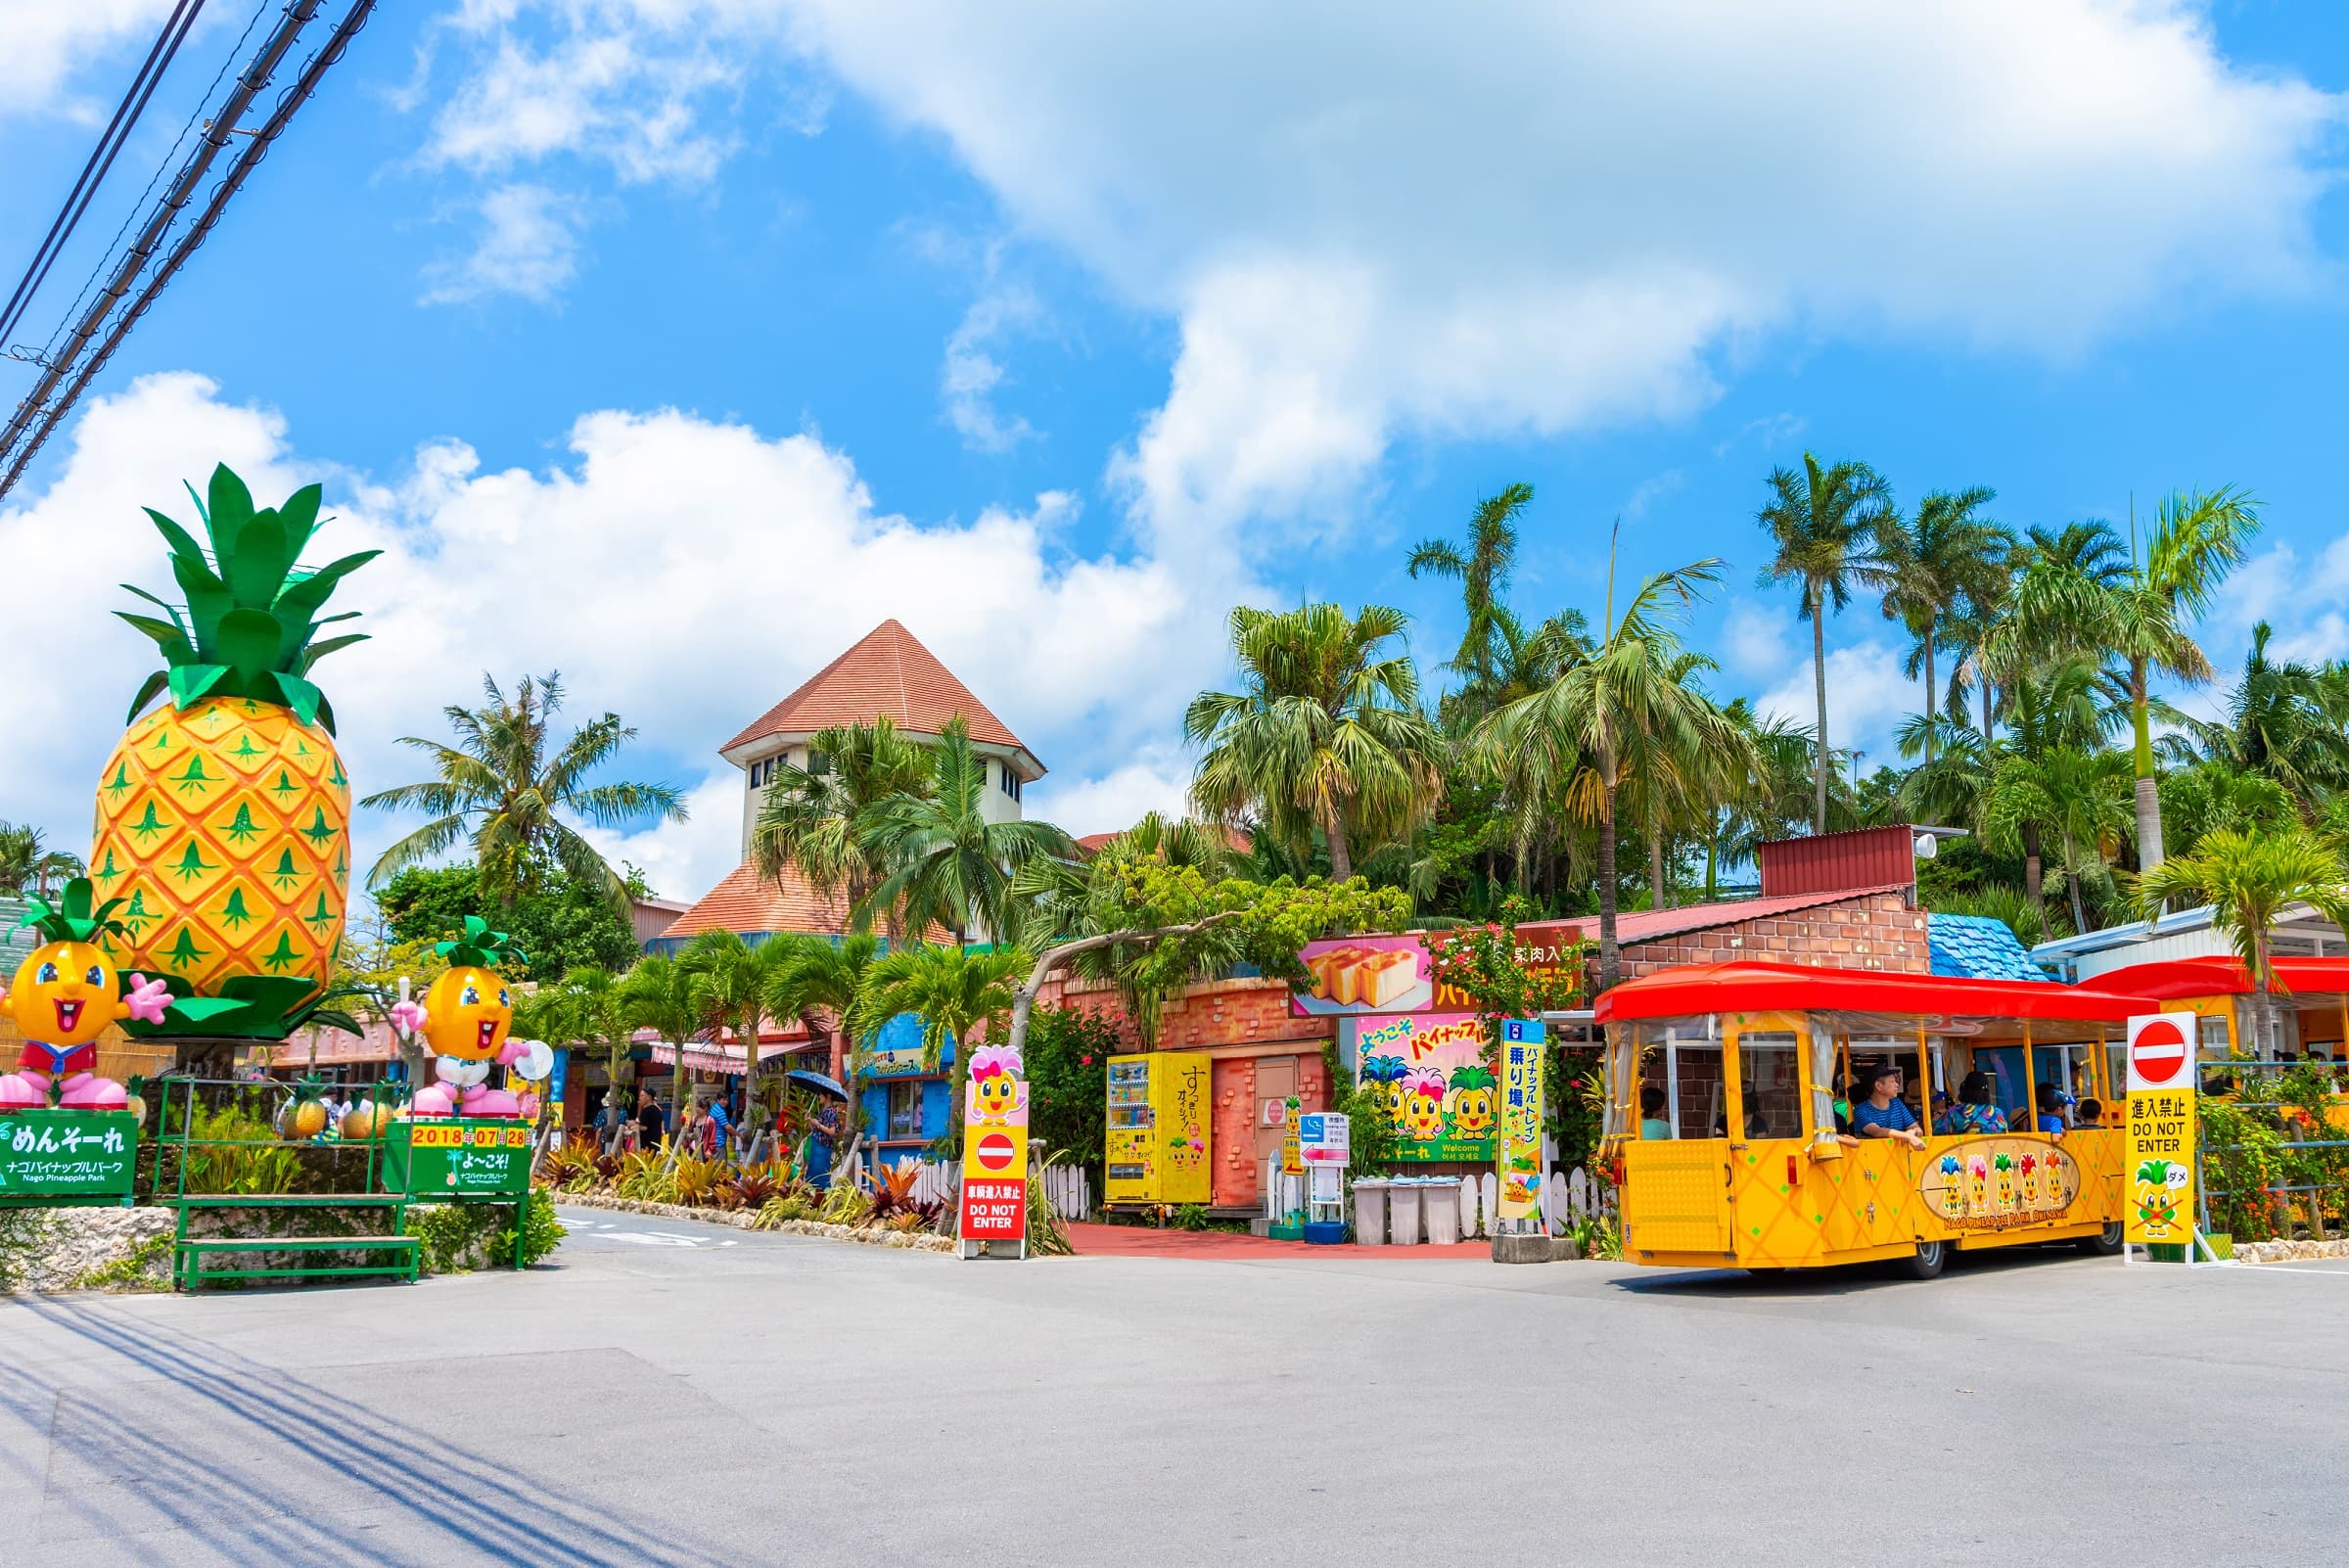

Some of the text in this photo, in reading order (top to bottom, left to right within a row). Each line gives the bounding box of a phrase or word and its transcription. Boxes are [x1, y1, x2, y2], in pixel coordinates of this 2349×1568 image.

[1359, 1018, 1413, 1053] ようこそ
[1508, 1046, 1524, 1108] 乗り場
[2132, 1097, 2186, 1119] 進入禁止
[2133, 1123, 2185, 1135] DO NOT
[13, 1125, 124, 1153] めんそーれ
[2138, 1139, 2180, 1152] ENTER
[23, 1174, 106, 1183] Nago Pineapple Park
[2168, 1171, 2186, 1182] ダメ
[970, 1204, 1017, 1217] DO NOT
[973, 1217, 1012, 1228] ENTER
[1944, 1217, 1966, 1230] NAGO
[1967, 1214, 2009, 1229] PINEAPPLE
[2009, 1211, 2031, 1225] PARK
